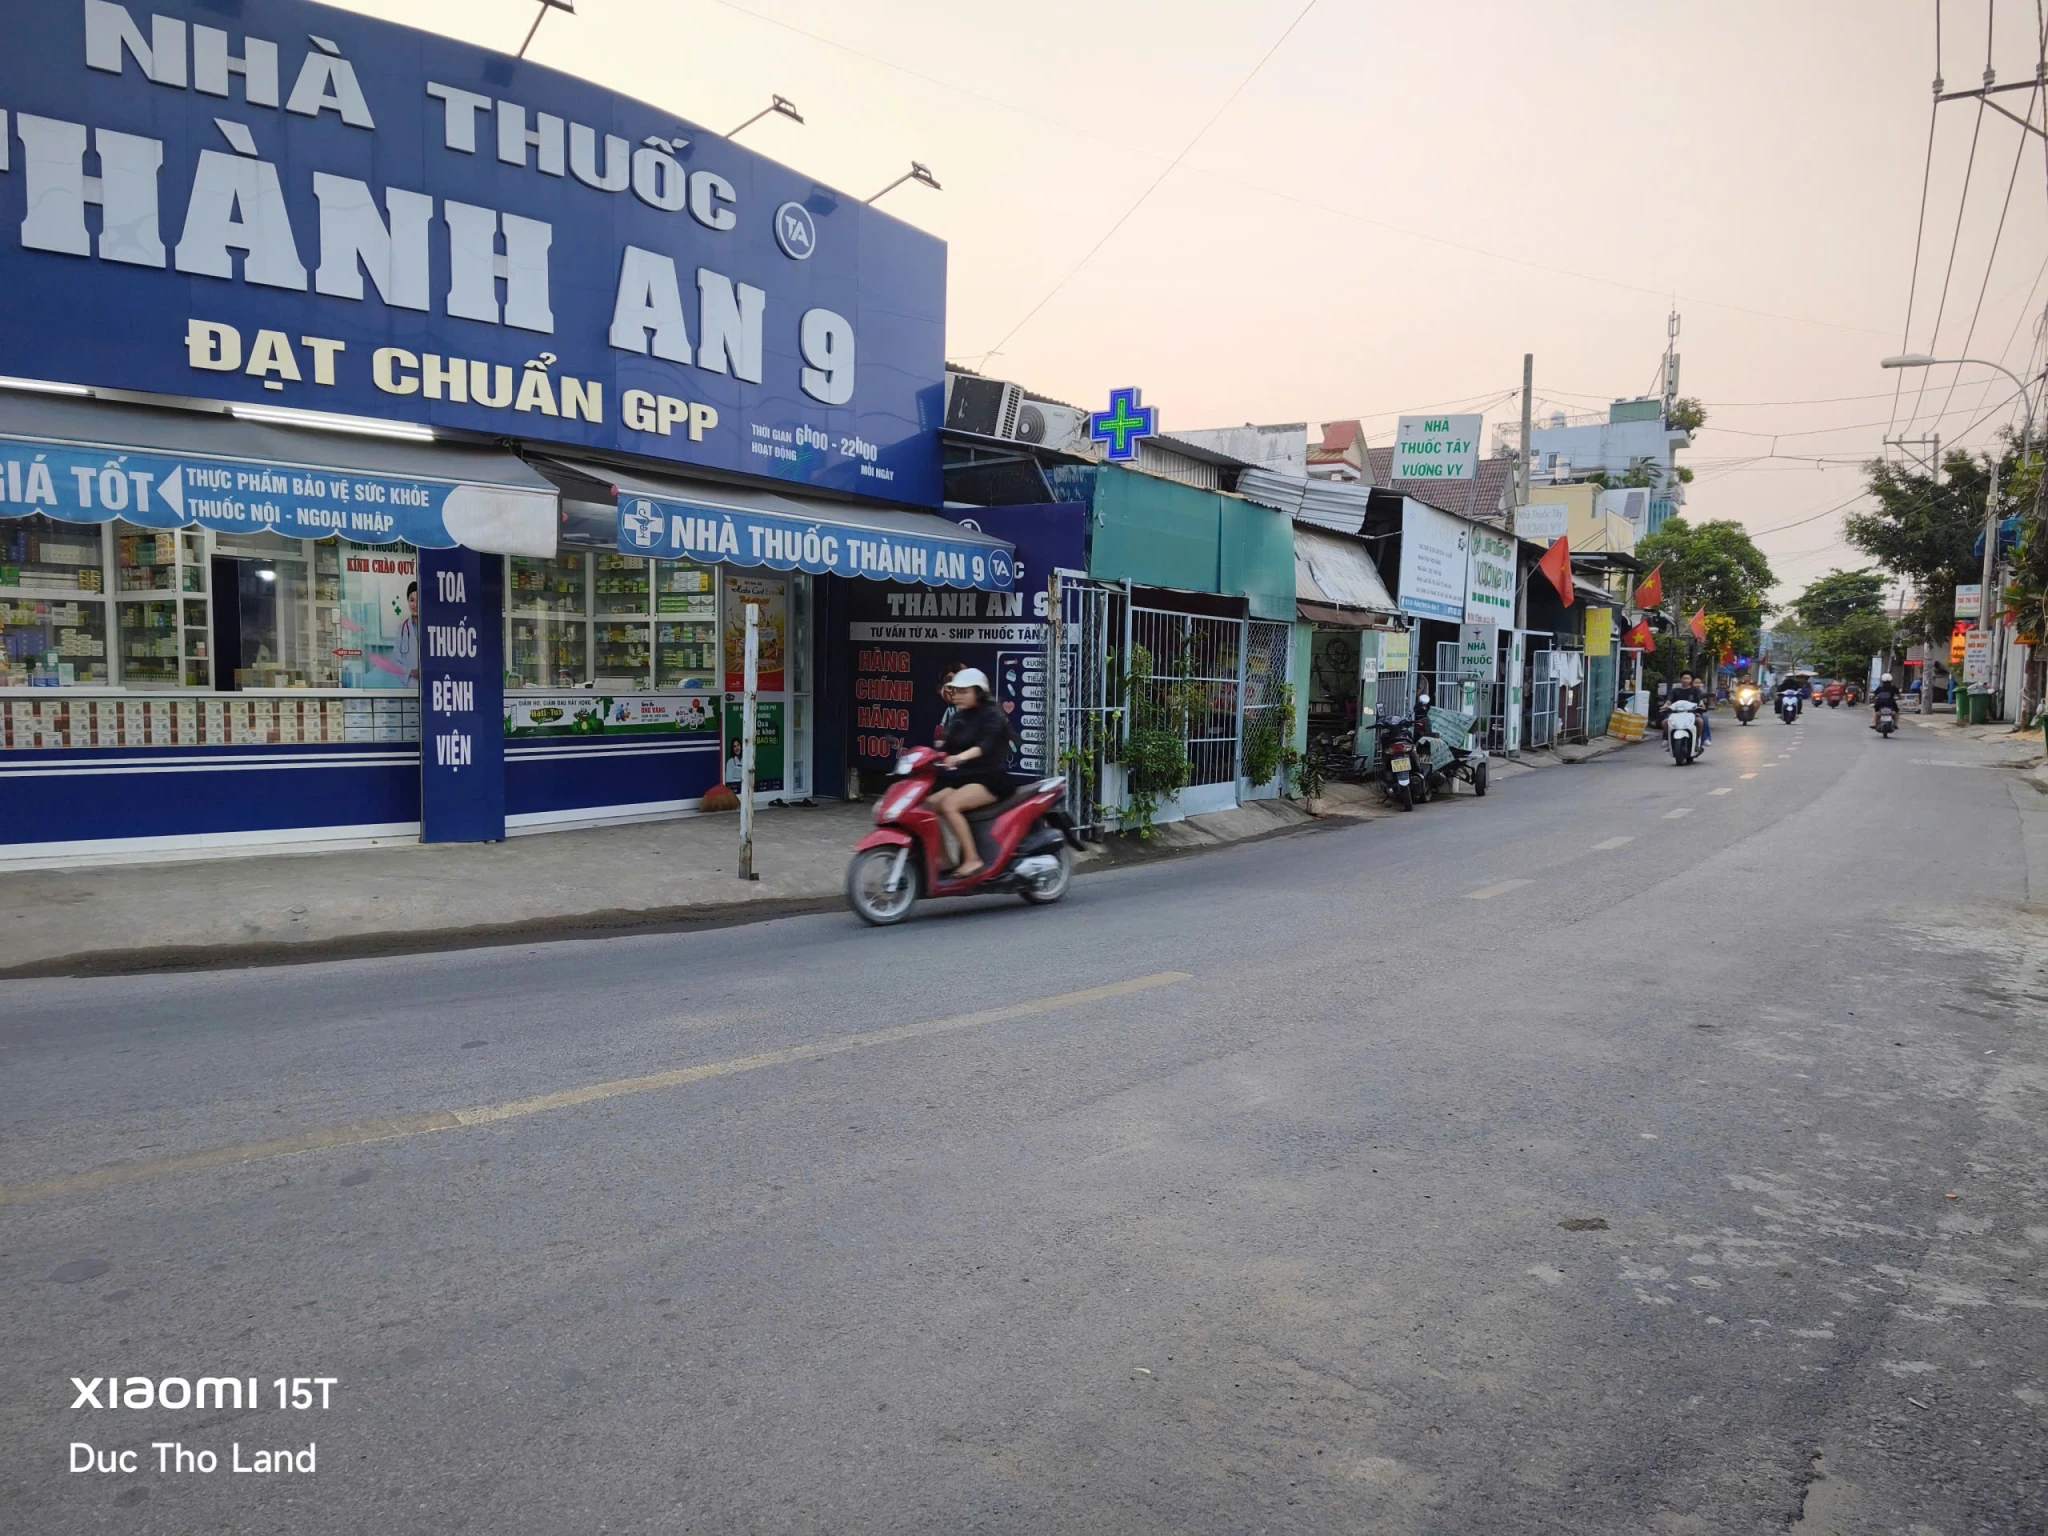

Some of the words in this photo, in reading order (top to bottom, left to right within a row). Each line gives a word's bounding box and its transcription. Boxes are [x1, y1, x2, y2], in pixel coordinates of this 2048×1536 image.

[85, 0, 375, 129] NHÀ
[427, 81, 737, 231] THUỐC
[0, 108, 554, 334] HÀNH
[609, 245, 765, 384] AN
[801, 308, 855, 405] 9
[185, 318, 346, 391] ĐẠT
[372, 352, 603, 424] CHUẨN
[622, 389, 719, 442] GPP
[751, 422, 770, 439] THỜI
[772, 428, 792, 443] GIAN
[1425, 417, 1449, 432] NHÀ
[751, 441, 773, 458] HOẠT
[774, 445, 797, 461] ĐỘNG
[1400, 437, 1441, 454] THUỐC
[1446, 438, 1471, 454] TÂY
[861, 462, 875, 477] MỖI
[876, 466, 894, 481] NGÀY
[1402, 462, 1443, 477] VƯƠNG
[1447, 463, 1463, 476] VY
[0, 454, 58, 505] IÁ
[71, 456, 154, 512] TỐT
[186, 467, 232, 492] THỰC
[237, 468, 287, 494] PHẨM
[293, 474, 325, 498] BẢO
[329, 480, 350, 502] VỆ
[355, 482, 385, 503] SỨC
[390, 484, 430, 507] KHỎE
[188, 495, 246, 520] THUỐC
[251, 502, 281, 527] NỘI
[351, 511, 394, 535] NHẬP
[671, 514, 739, 555] NHÀ
[748, 523, 839, 566] THUỐC
[847, 538, 927, 576] THÀNH
[934, 551, 966, 580] AN
[972, 556, 985, 582] 9
[347, 555, 370, 573] KÍNH
[372, 557, 396, 574] CHÀO
[398, 559, 415, 576] QUÝ
[437, 571, 466, 603] TOA
[887, 587, 976, 617] THÀNH
[986, 591, 1024, 617] AN
[1033, 592, 1048, 617] 9
[427, 615, 477, 658] THUỐC
[871, 626, 884, 638] TƯ
[886, 624, 907, 638] VẤN
[909, 625, 923, 639] TỪ
[925, 627, 938, 639] XA
[949, 628, 974, 640] SHIP
[978, 625, 1014, 640] THUỐC
[1468, 640, 1486, 651] NHÀ
[859, 647, 910, 672] HÀNG
[1461, 653, 1493, 665] THUỐC
[432, 674, 474, 717] BỆNH
[856, 676, 913, 701] CHÍNH
[857, 704, 909, 730] HÃNG
[436, 729, 472, 772] VIỆN
[857, 735, 908, 759] 100%
